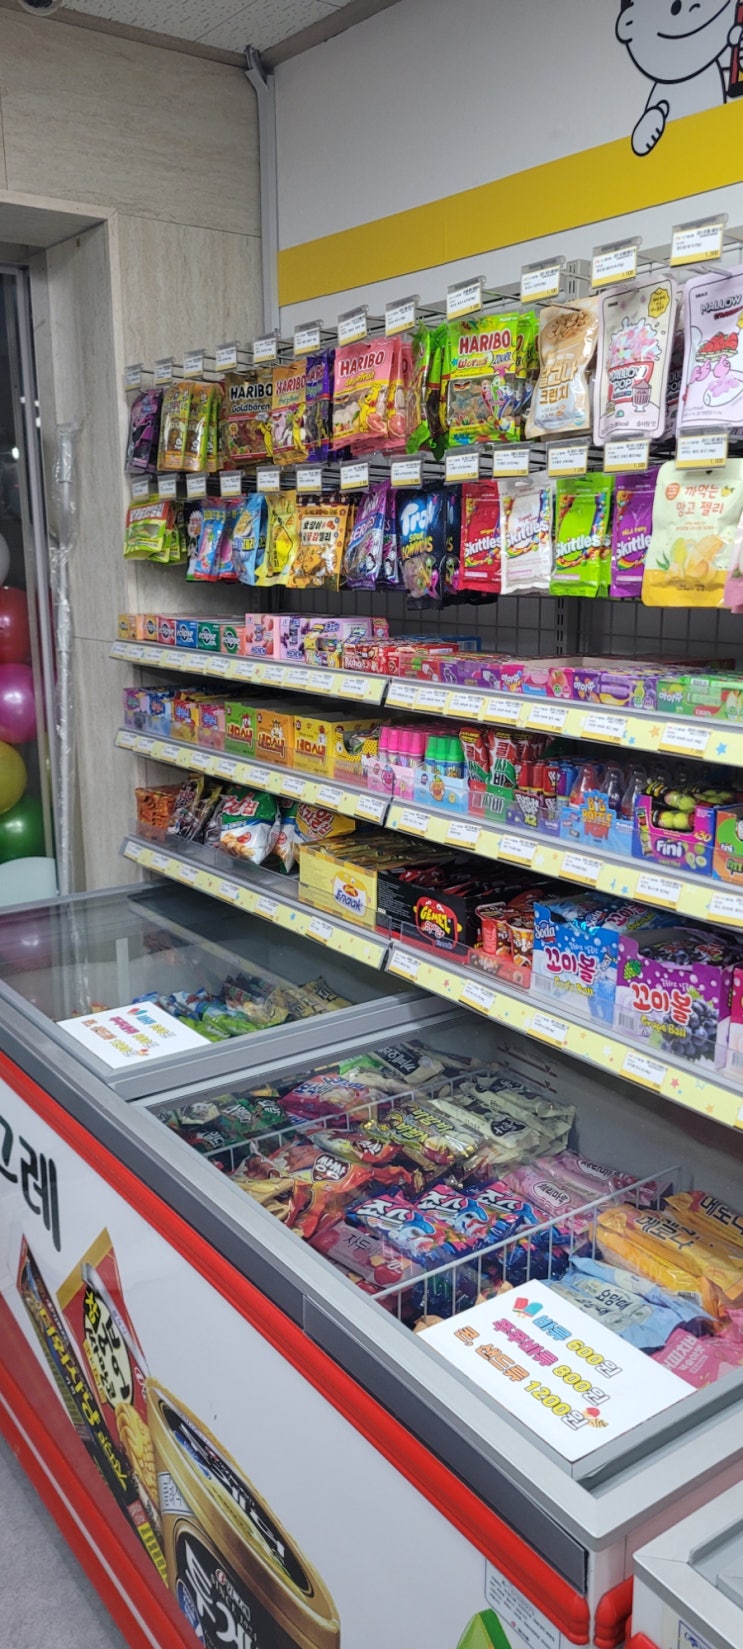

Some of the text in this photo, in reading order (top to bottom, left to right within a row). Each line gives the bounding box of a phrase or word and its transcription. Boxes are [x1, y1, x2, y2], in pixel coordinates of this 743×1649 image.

[701, 296, 742, 315] MALLOW
[459, 330, 511, 355] HARIBO
[338, 350, 386, 378] HARIBO
[230, 383, 273, 401] HARIBO
[276, 375, 306, 396] HARIBO
[539, 383, 569, 405] 크런치
[614, 379, 632, 391] POP
[684, 483, 720, 498] 까먹는
[676, 501, 725, 517] 망고 젤리
[506, 520, 550, 548] Skittles
[556, 534, 601, 557] Skittles
[616, 534, 652, 558] Skittle
[656, 839, 683, 858] Fini
[535, 925, 556, 939] Soda
[544, 947, 596, 984] 꼬미볼
[630, 982, 692, 1025] 꼬미볼
[640, 1014, 687, 1038] Grape Ball
[344, 1232, 376, 1253] 자두
[636, 1216, 694, 1250] 메로나
[596, 1288, 634, 1312] 요맘때
[532, 1314, 623, 1378] 바류 600원
[40, 1309, 99, 1427] 더위사냥
[492, 1318, 611, 1406] 쭈쭈바류 800원
[525, 1379, 589, 1431] 1200원
